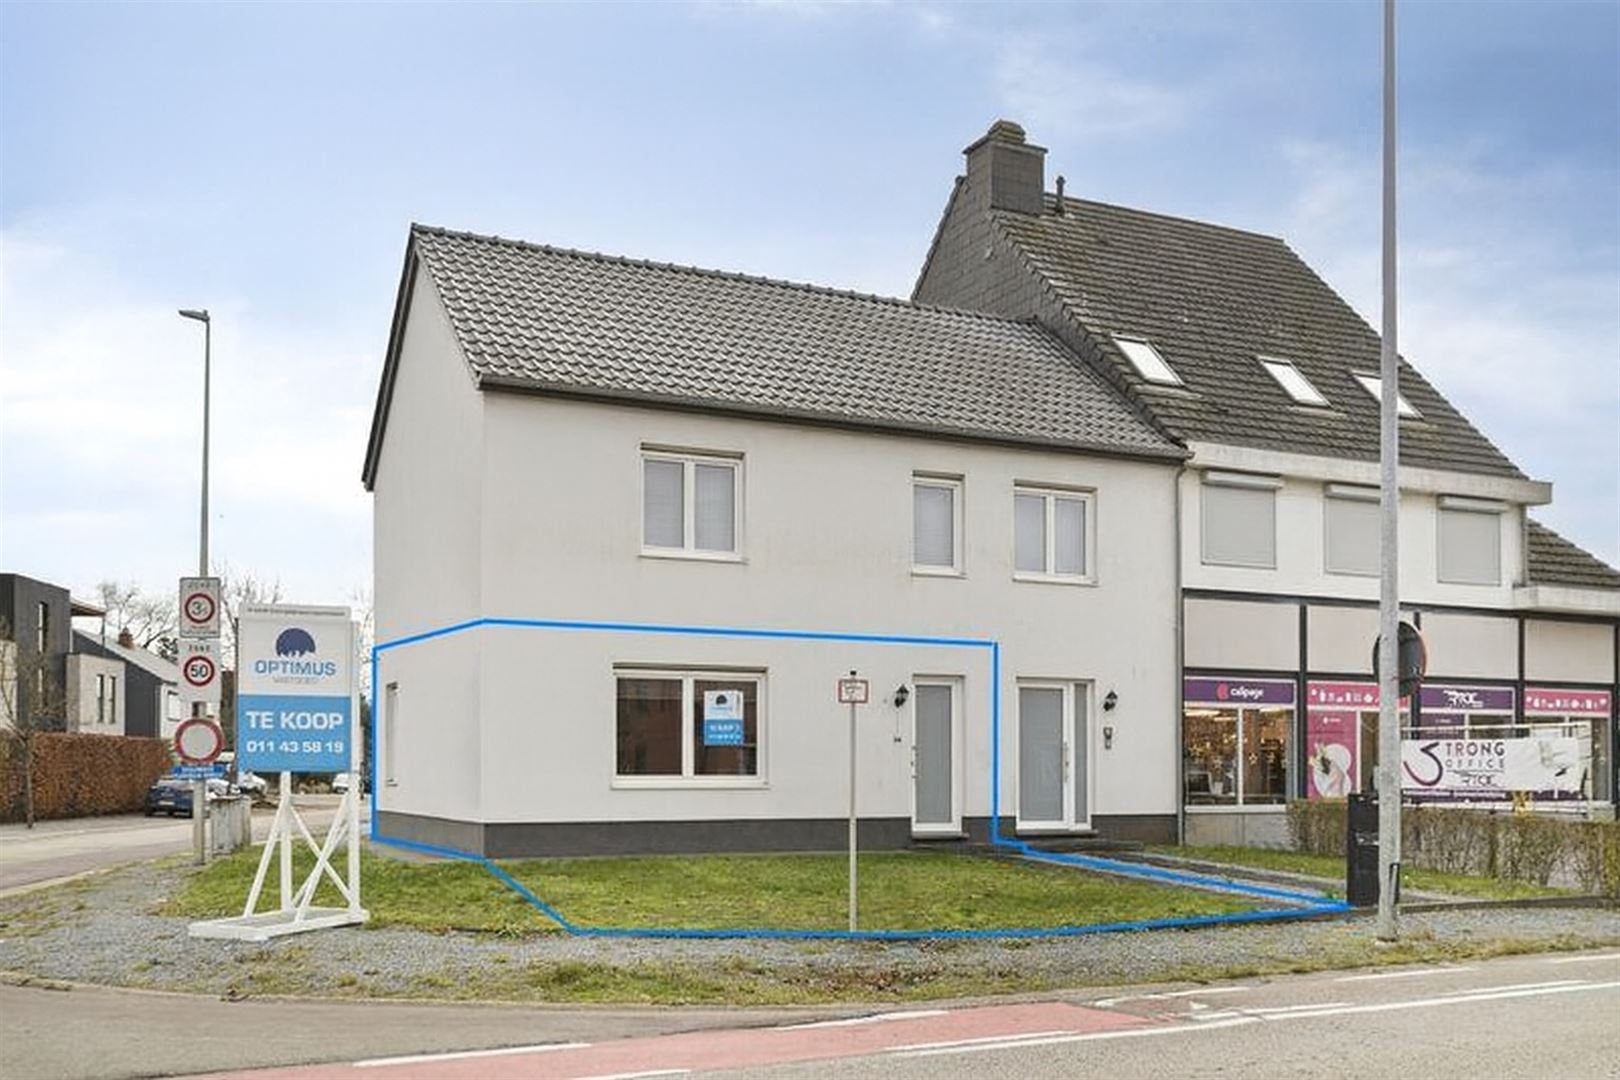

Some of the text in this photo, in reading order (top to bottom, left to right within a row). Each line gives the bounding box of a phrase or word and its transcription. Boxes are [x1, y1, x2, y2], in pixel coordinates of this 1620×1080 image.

[191, 665, 207, 677] 50
[255, 659, 336, 676] OPTIMUS
[246, 711, 343, 730] TE KOOP
[246, 740, 275, 752] 011
[279, 741, 298, 752] 43
[303, 741, 321, 752] 58
[1445, 759, 1505, 769] OFFICE
